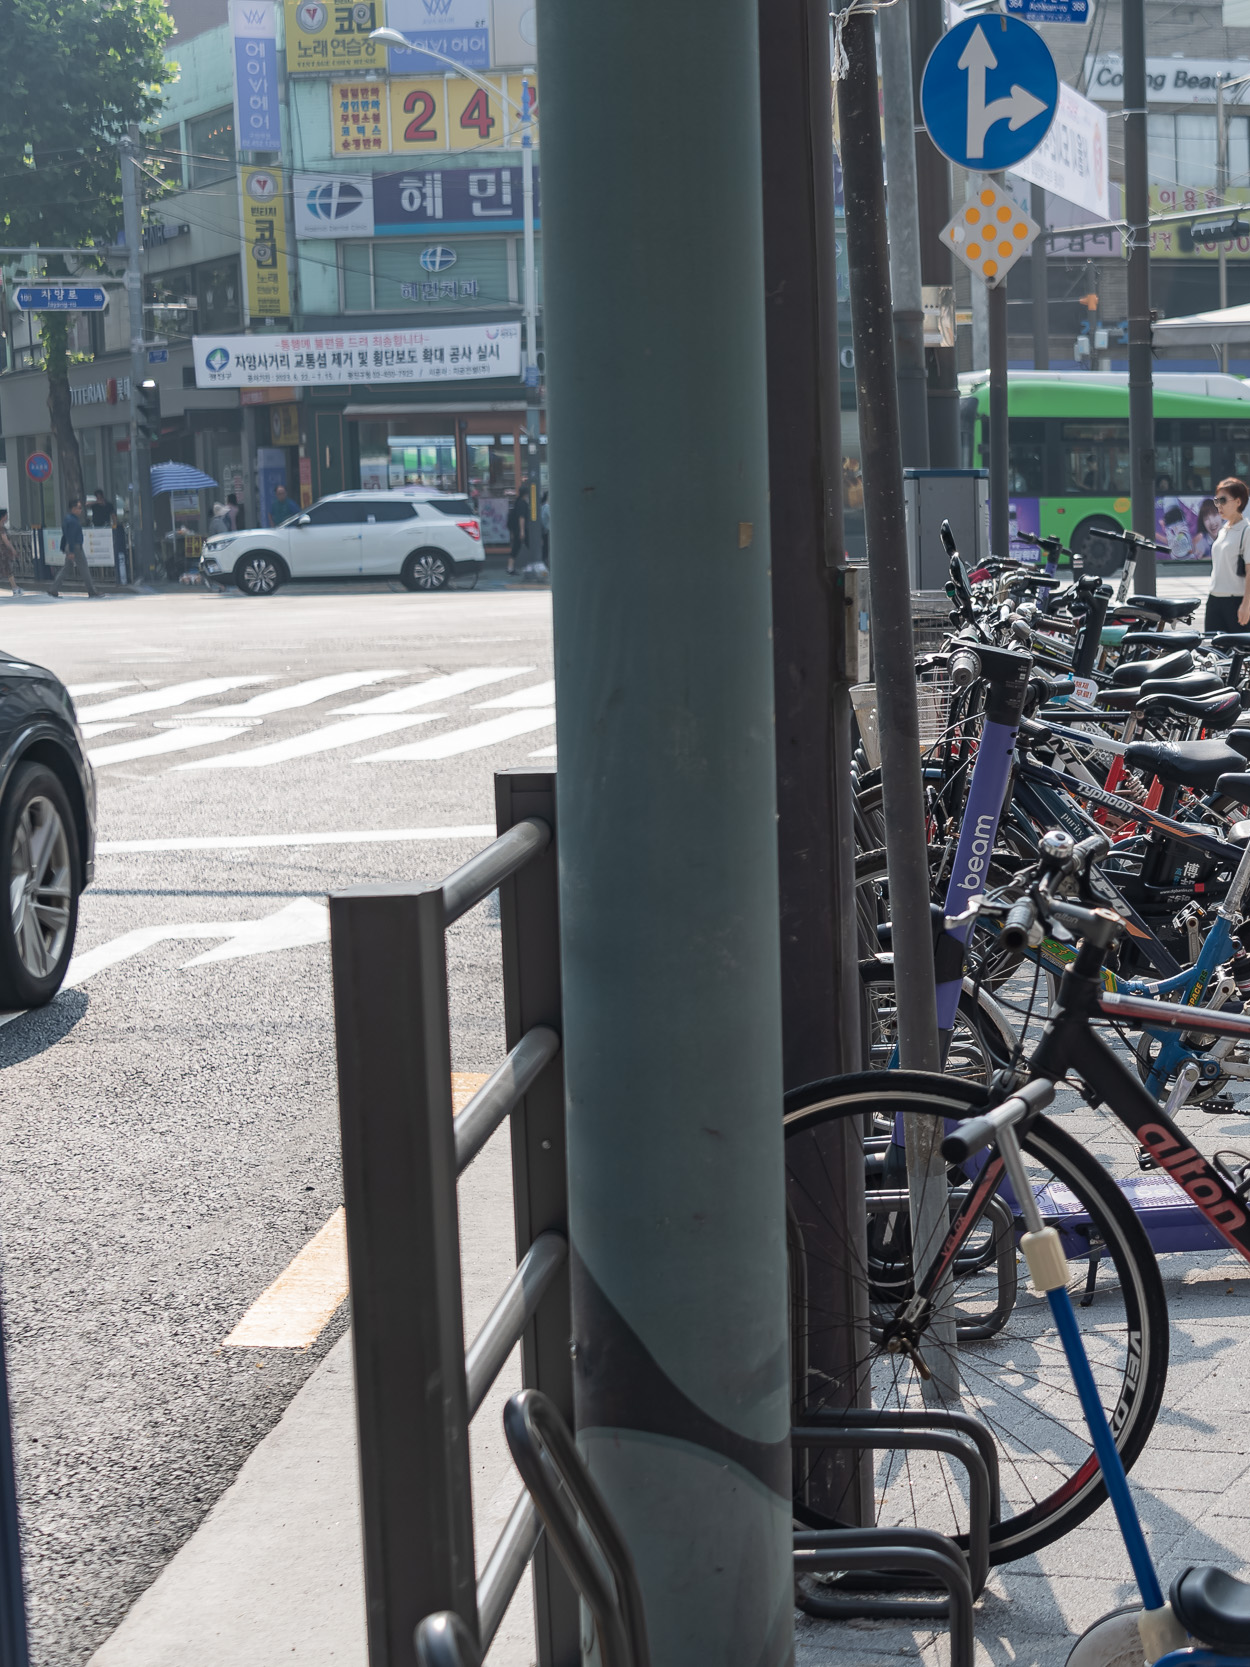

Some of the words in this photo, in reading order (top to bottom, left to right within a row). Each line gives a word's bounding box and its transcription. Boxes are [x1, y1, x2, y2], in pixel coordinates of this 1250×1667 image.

[297, 39, 328, 58] 노래
[331, 38, 376, 57] 연습장
[245, 41, 269, 130] 에이바헤어
[41, 289, 78, 301] 자양로
[401, 279, 479, 301] 혜민치과
[314, 337, 345, 350] 불편을
[348, 336, 369, 347] 드려
[234, 352, 290, 371] 자양사거리
[294, 351, 327, 370] 교통섬
[331, 350, 353, 368] 제거
[358, 350, 368, 367] 및
[373, 348, 418, 367] 횡단보도
[422, 347, 445, 365] 확대
[449, 345, 472, 364] 공사
[476, 343, 500, 362] 실시
[1074, 680, 1089, 689] 해제
[1076, 689, 1092, 699] 무료!
[1060, 812, 1084, 839] purity.
[956, 814, 994, 890] beam
[1053, 911, 1079, 925] alton
[1136, 1122, 1246, 1231] alton
